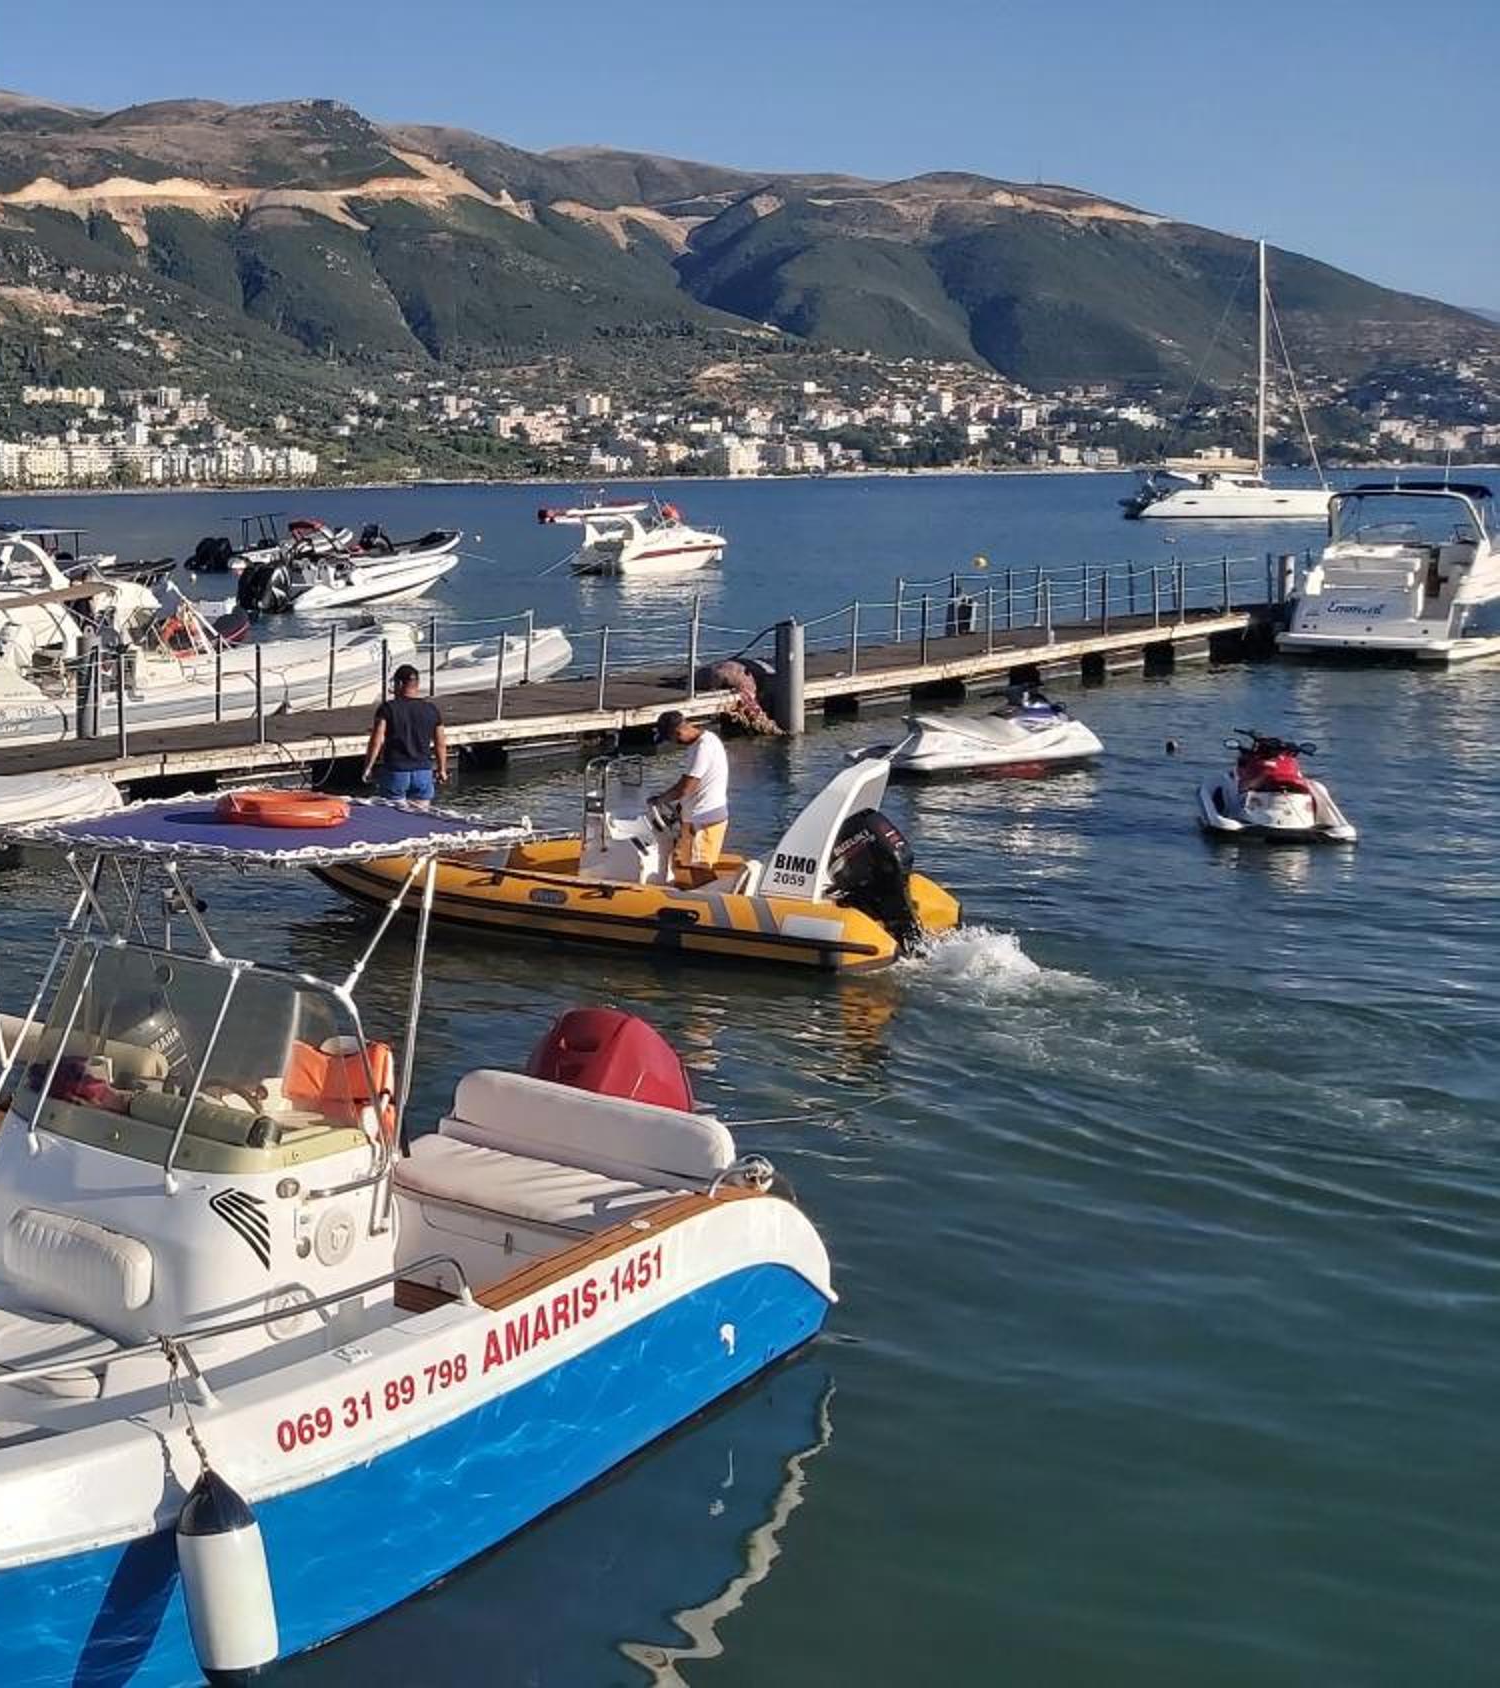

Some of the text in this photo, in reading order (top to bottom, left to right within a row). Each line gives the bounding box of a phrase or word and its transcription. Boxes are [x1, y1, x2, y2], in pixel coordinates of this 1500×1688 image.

[774, 853, 817, 875] BIMO
[773, 871, 806, 887] 2059
[150, 1026, 180, 1054] MAHA
[276, 1407, 334, 1453] 069
[342, 1391, 373, 1429] 31
[384, 1375, 415, 1412] 89
[423, 1353, 468, 1395] 798
[481, 1244, 664, 1375] AMARIS-1451
